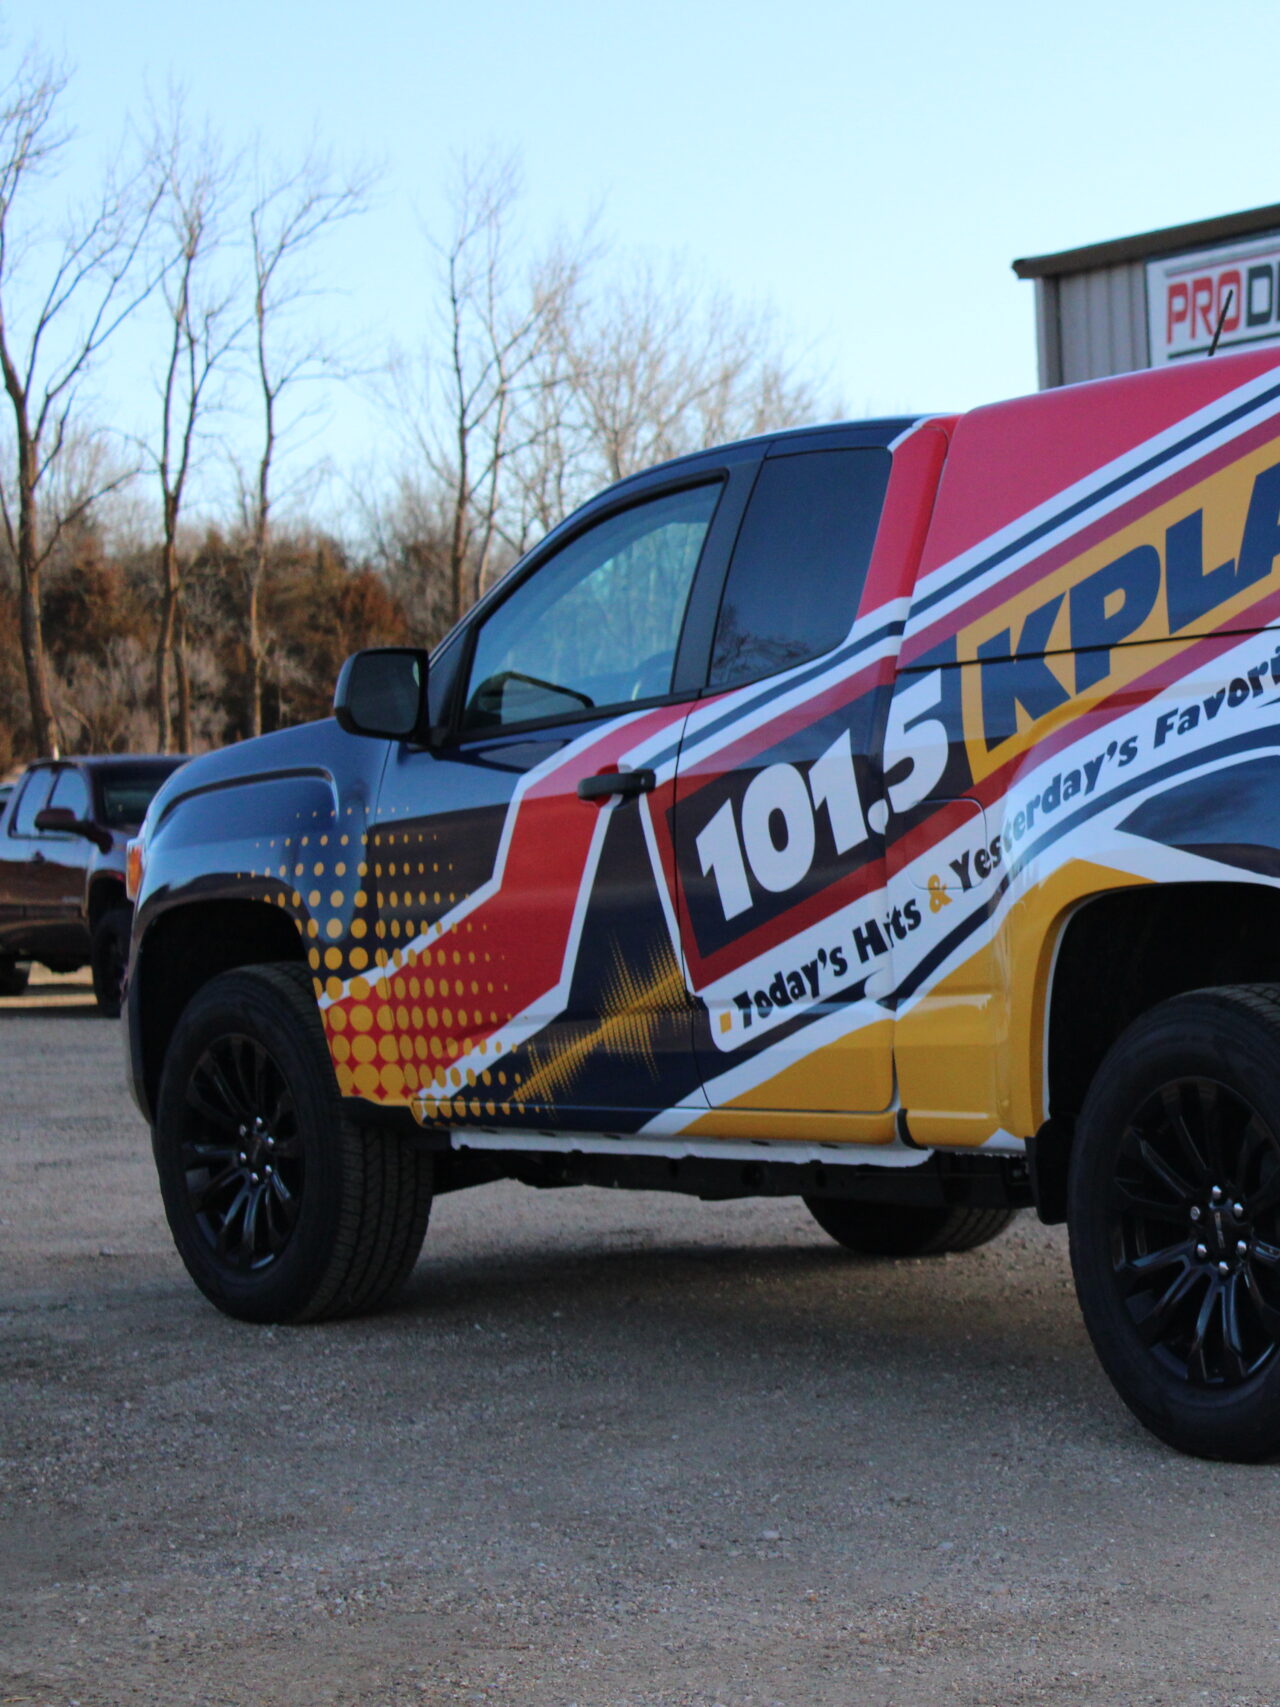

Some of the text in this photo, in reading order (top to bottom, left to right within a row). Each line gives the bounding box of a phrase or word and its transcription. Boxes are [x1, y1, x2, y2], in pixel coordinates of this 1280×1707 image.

[695, 667, 949, 922] 101.5
[732, 946, 848, 1030] Today's
[851, 898, 922, 965] Hits
[928, 874, 953, 914] &
[948, 735, 1139, 893] Yesterday's
